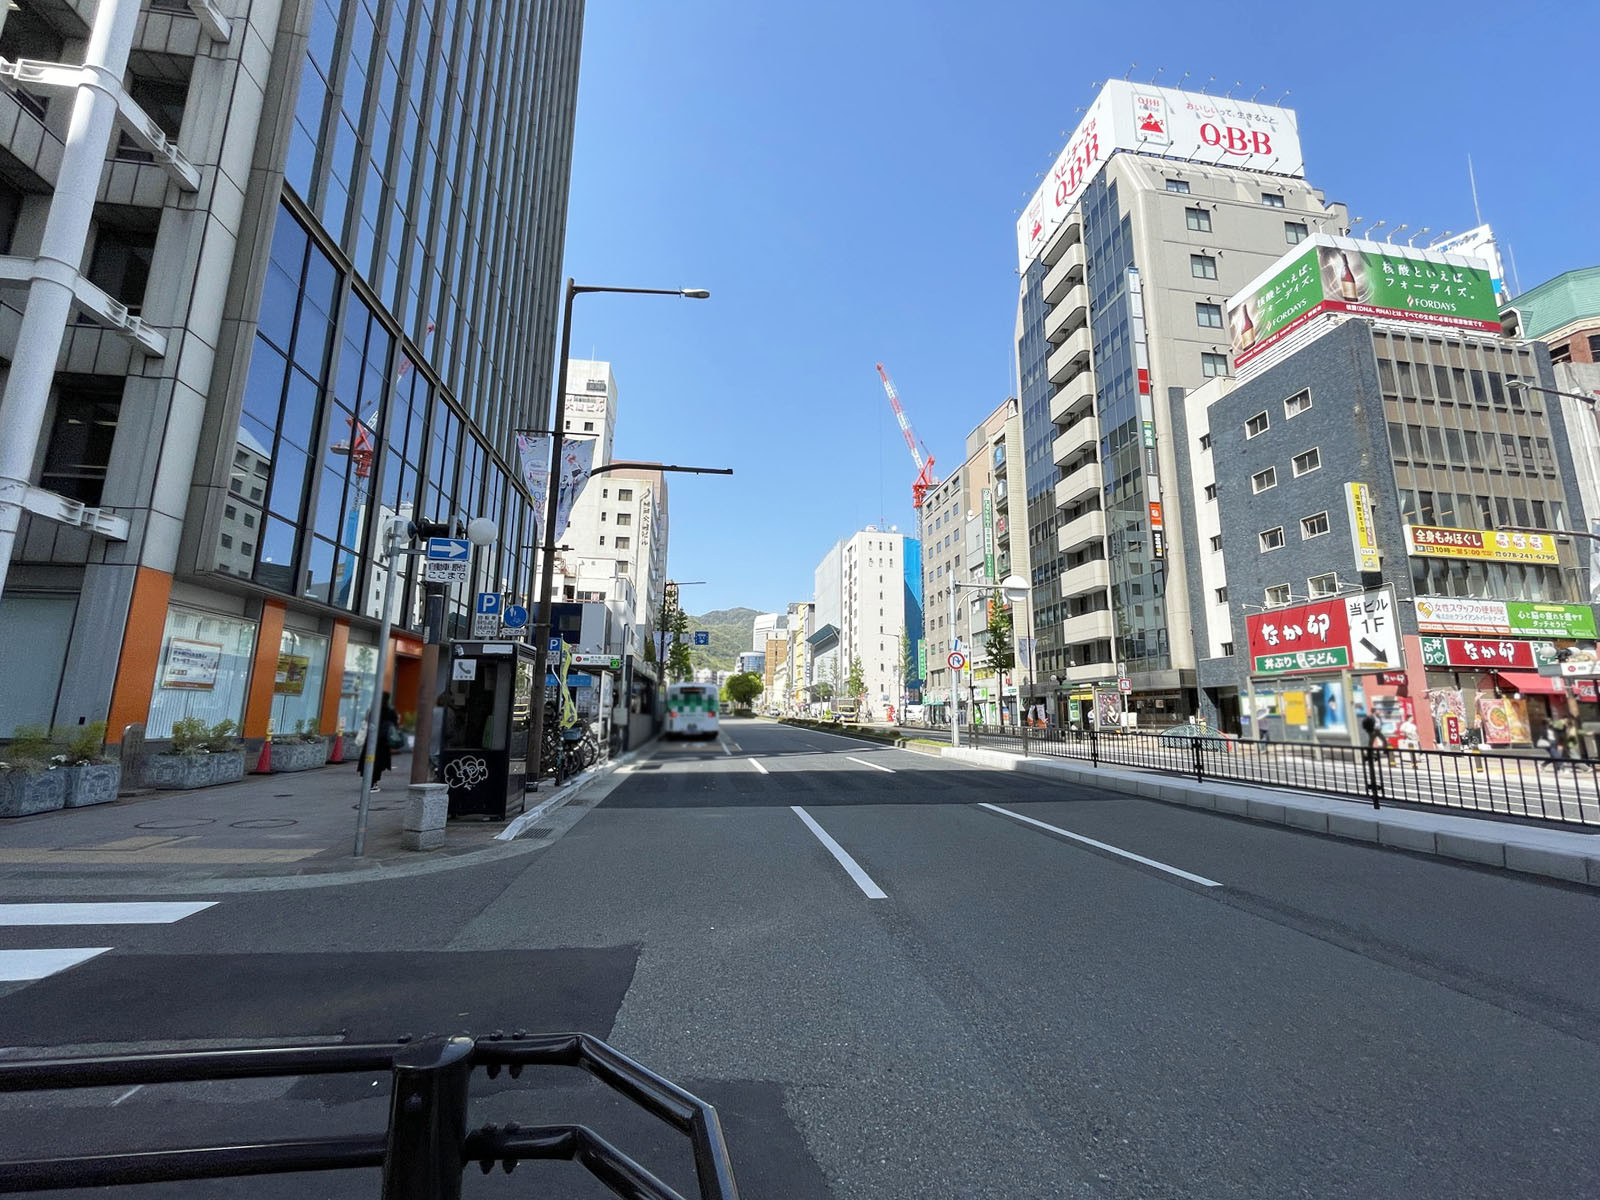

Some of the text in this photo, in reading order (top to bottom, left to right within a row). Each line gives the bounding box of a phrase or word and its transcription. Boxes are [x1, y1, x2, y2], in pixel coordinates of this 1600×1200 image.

[1272, 298, 1307, 326] FORDAYS
[1415, 298, 1457, 312] FORDAYS
[1416, 529, 1481, 546] 全身もみほぐし
[428, 571, 466, 580] ここまで
[482, 594, 496, 612] P
[1350, 598, 1388, 616] 当ビル
[1261, 613, 1330, 646] なか卯
[1361, 616, 1384, 634] 1F
[549, 639, 559, 650] P
[1463, 640, 1514, 664] なか卯
